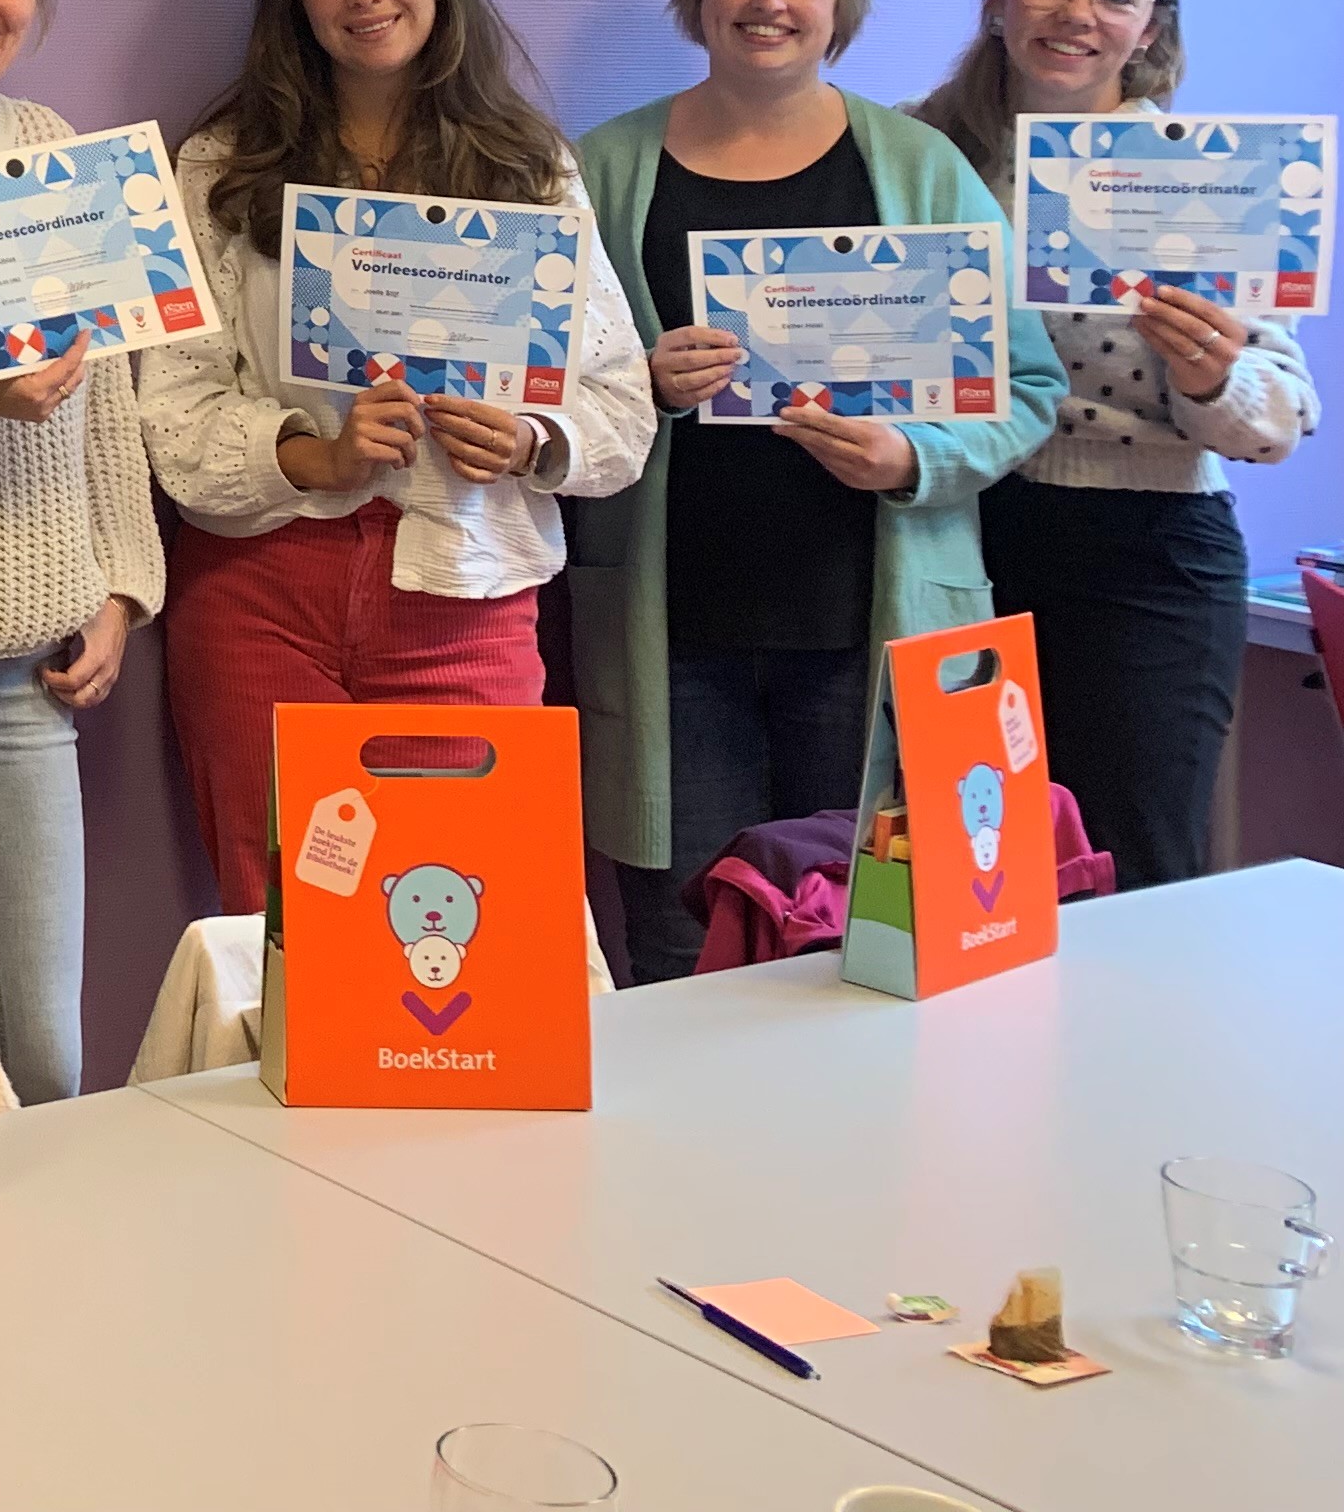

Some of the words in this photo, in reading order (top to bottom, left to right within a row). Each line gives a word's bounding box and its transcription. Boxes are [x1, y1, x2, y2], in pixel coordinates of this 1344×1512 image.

[1089, 179, 1258, 196] Voorleescoördinator
[352, 247, 402, 260] Certificaat
[352, 258, 512, 286] Voorleescoördinator
[764, 291, 927, 308] Voorleescoördinator
[377, 1045, 497, 1072] BoekStart
